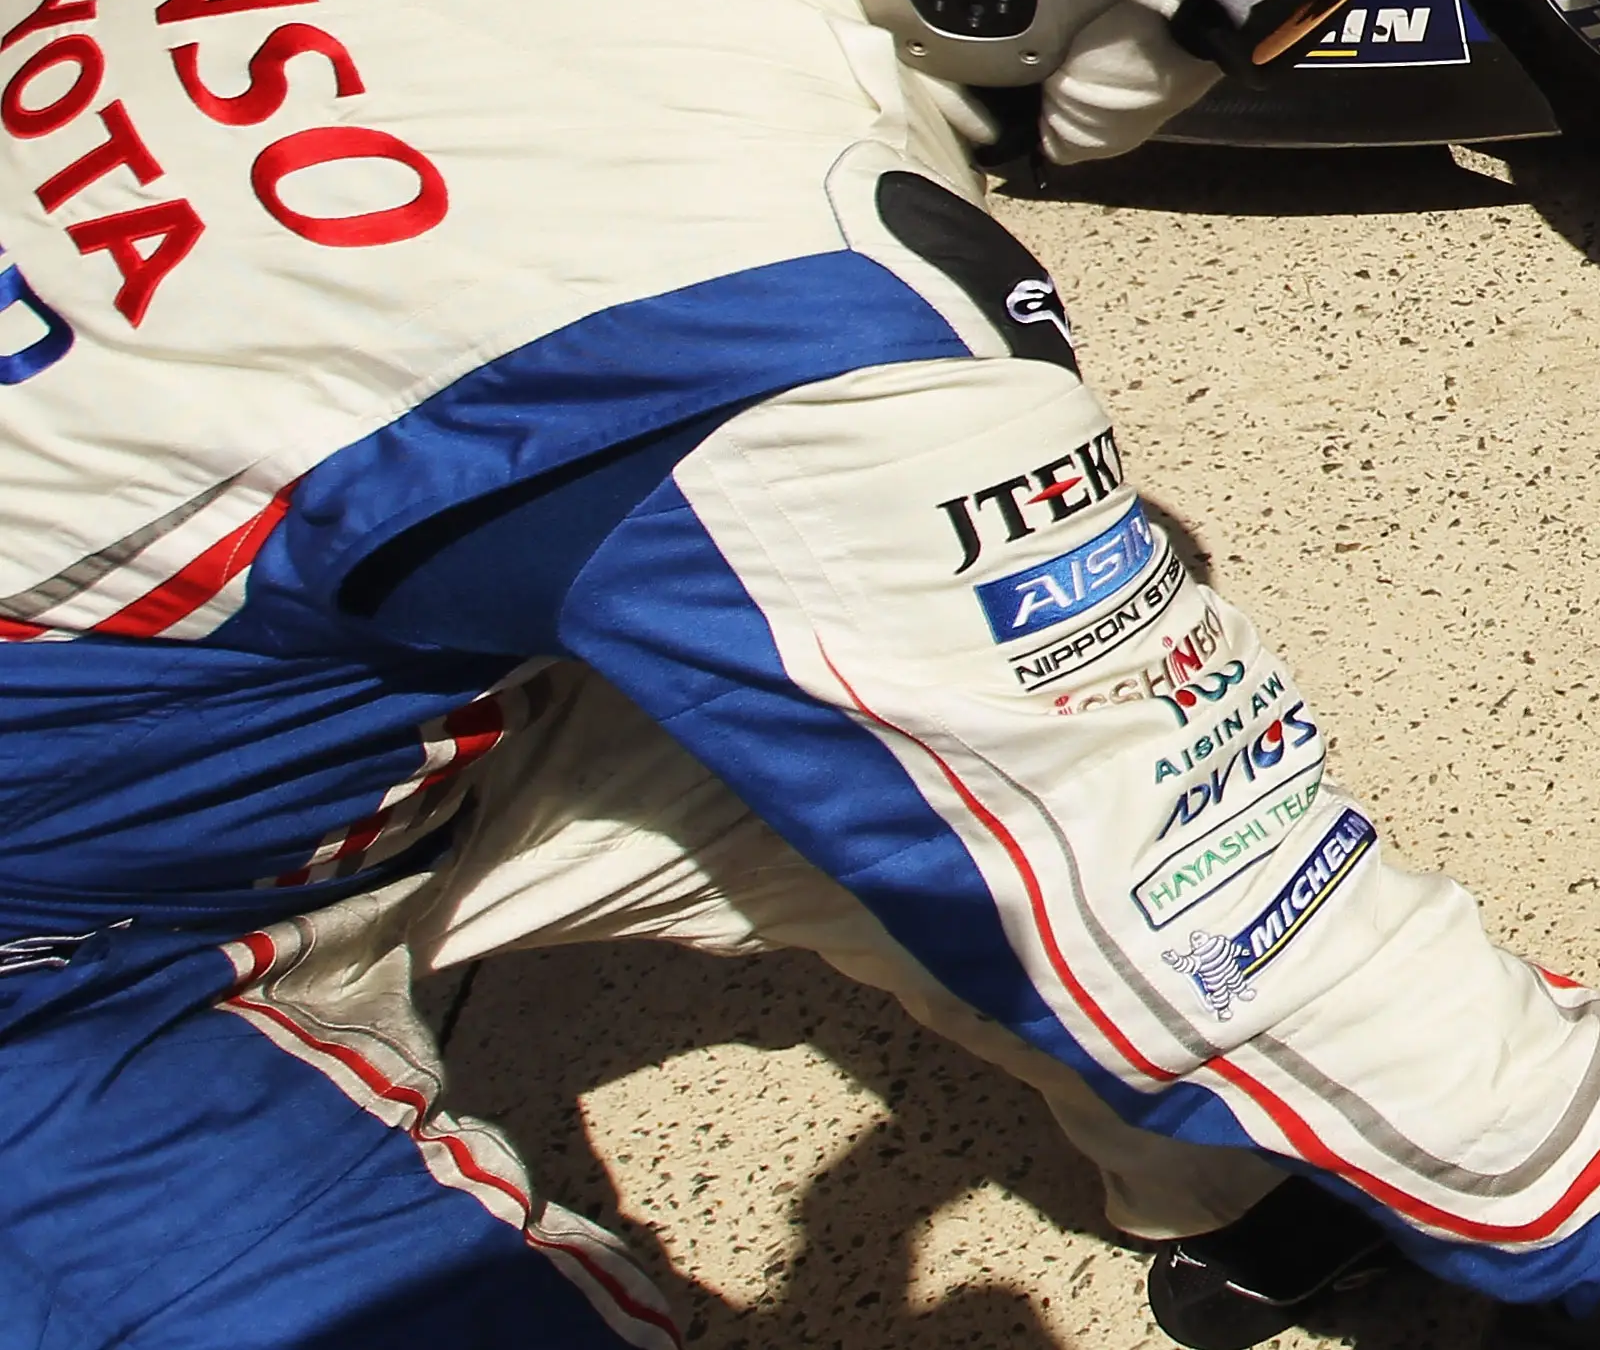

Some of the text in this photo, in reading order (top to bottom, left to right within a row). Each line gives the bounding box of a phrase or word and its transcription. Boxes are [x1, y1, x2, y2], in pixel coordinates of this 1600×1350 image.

[1012, 515, 1153, 630] AISIN
[1013, 603, 1142, 685] NIPPON
[1053, 605, 1224, 717] SSHINBO
[1154, 671, 1286, 785] AISIN AW
[1154, 700, 1318, 842] ADVICS
[1149, 817, 1269, 912] HAYASHI
[1249, 813, 1373, 959] MICHELIN
